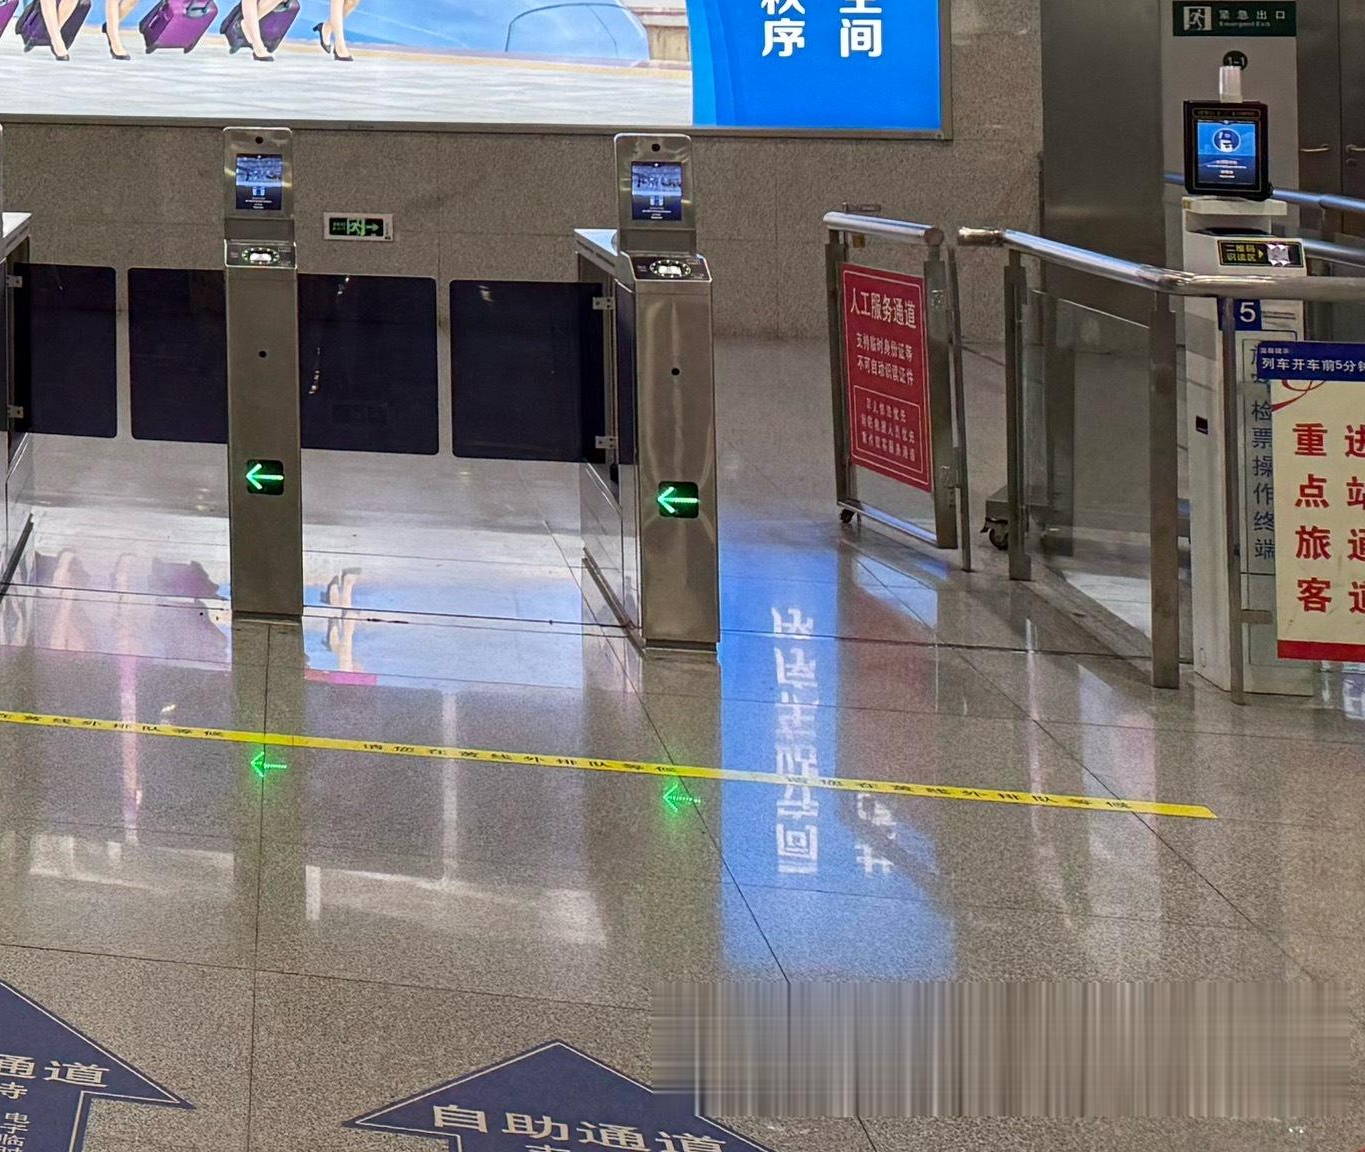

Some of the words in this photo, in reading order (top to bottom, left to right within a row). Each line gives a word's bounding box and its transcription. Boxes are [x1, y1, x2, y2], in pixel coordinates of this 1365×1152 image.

[850, 287, 917, 329] 人工服务通道
[1240, 301, 1256, 323] 5
[1292, 422, 1332, 614] 重点旅客
[432, 1103, 727, 1152] 自助通道
